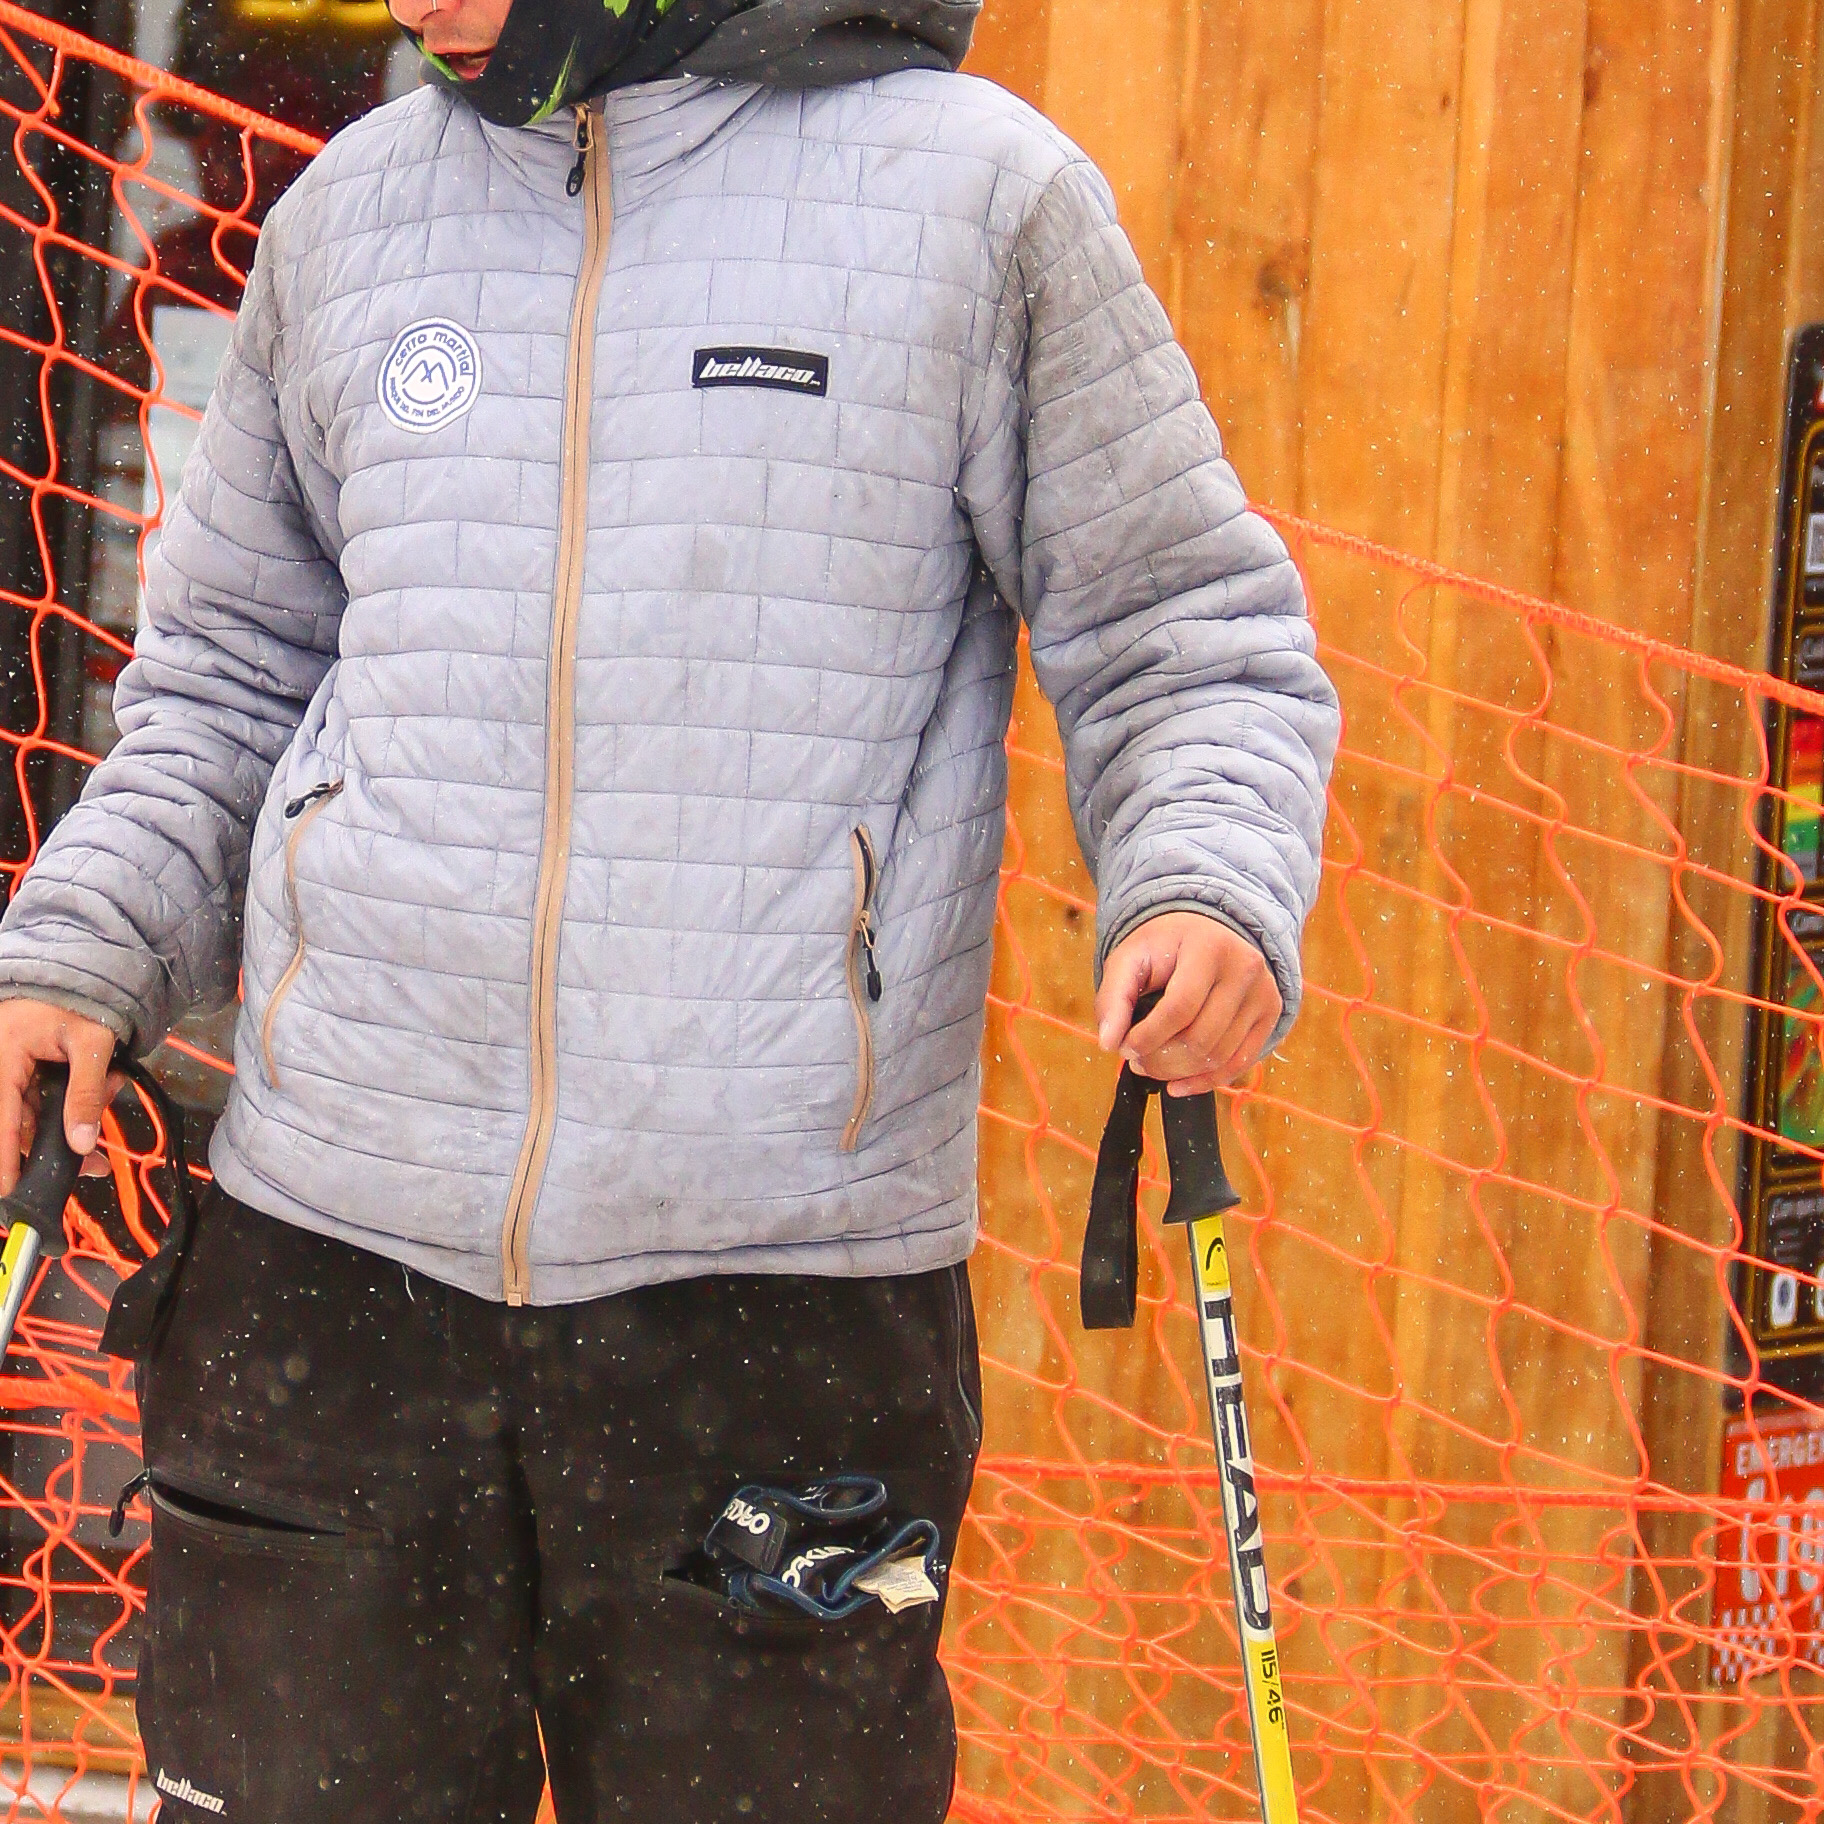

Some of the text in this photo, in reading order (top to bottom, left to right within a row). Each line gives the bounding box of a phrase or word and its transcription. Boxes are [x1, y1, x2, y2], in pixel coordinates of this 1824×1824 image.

[396, 331, 474, 376] cerro martial
[699, 356, 816, 385] bellaco
[1203, 1297, 1273, 1630] HEAD
[157, 1768, 225, 1814] bellaco
